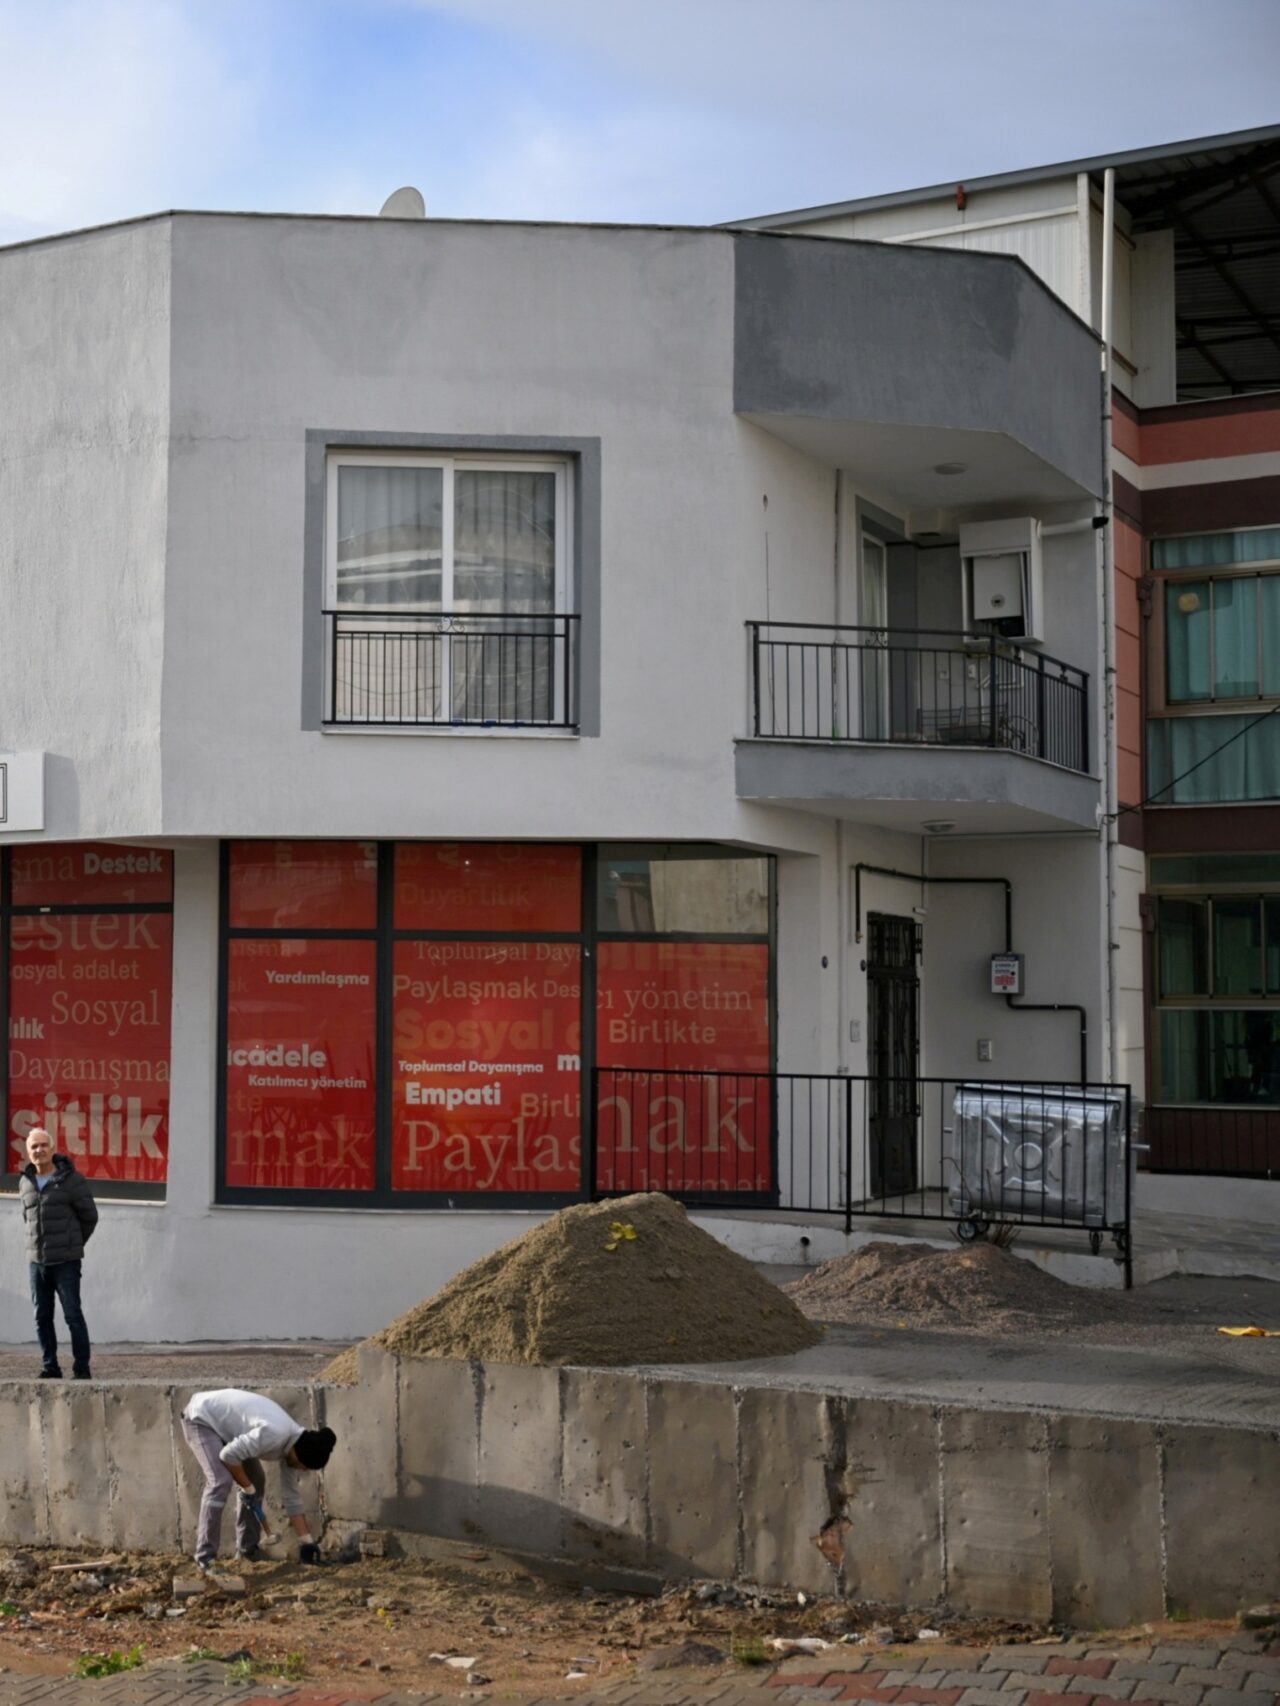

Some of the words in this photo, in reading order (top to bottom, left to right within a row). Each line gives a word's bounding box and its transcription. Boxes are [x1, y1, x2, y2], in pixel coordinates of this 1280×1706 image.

[83, 851, 163, 876] Destek
[72, 960, 141, 980] adalet
[265, 969, 369, 989] Yardımlaşma
[394, 976, 538, 1004] Paylaşmak
[624, 982, 753, 1017] yönetim
[51, 989, 161, 1036] Sosyal
[395, 1008, 553, 1061] Sosyal
[608, 1019, 717, 1043] Birlikte
[10, 1050, 172, 1091] Dayanışma
[398, 1060, 467, 1075] Toplumsal
[468, 1062, 544, 1077] Dayanışma
[248, 1074, 308, 1088] Katılımcı
[311, 1077, 367, 1090] yönetim
[405, 1081, 501, 1111] Empati
